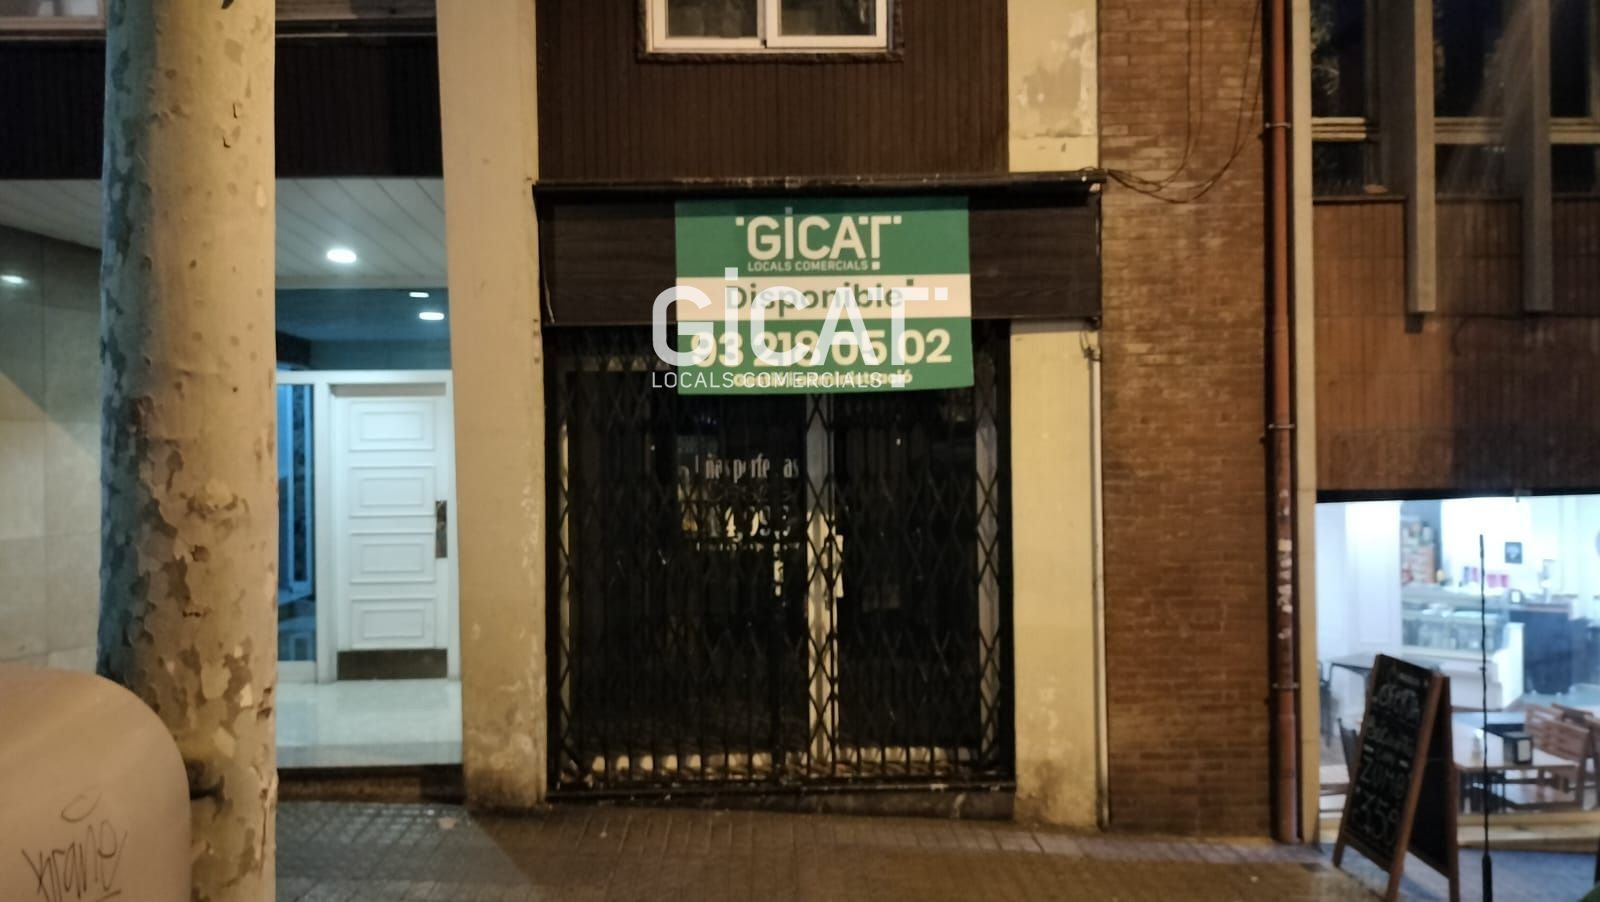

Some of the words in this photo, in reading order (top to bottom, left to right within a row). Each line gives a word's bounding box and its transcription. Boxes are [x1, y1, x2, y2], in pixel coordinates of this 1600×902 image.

[745, 207, 902, 261] GICAT
[748, 260, 792, 272] LOCALS
[795, 259, 869, 271] COMERCIALS
[726, 282, 904, 318] Disponible
[690, 330, 744, 368] 93
[753, 330, 821, 368] 218
[832, 329, 888, 366] 05
[897, 328, 953, 364] 02
